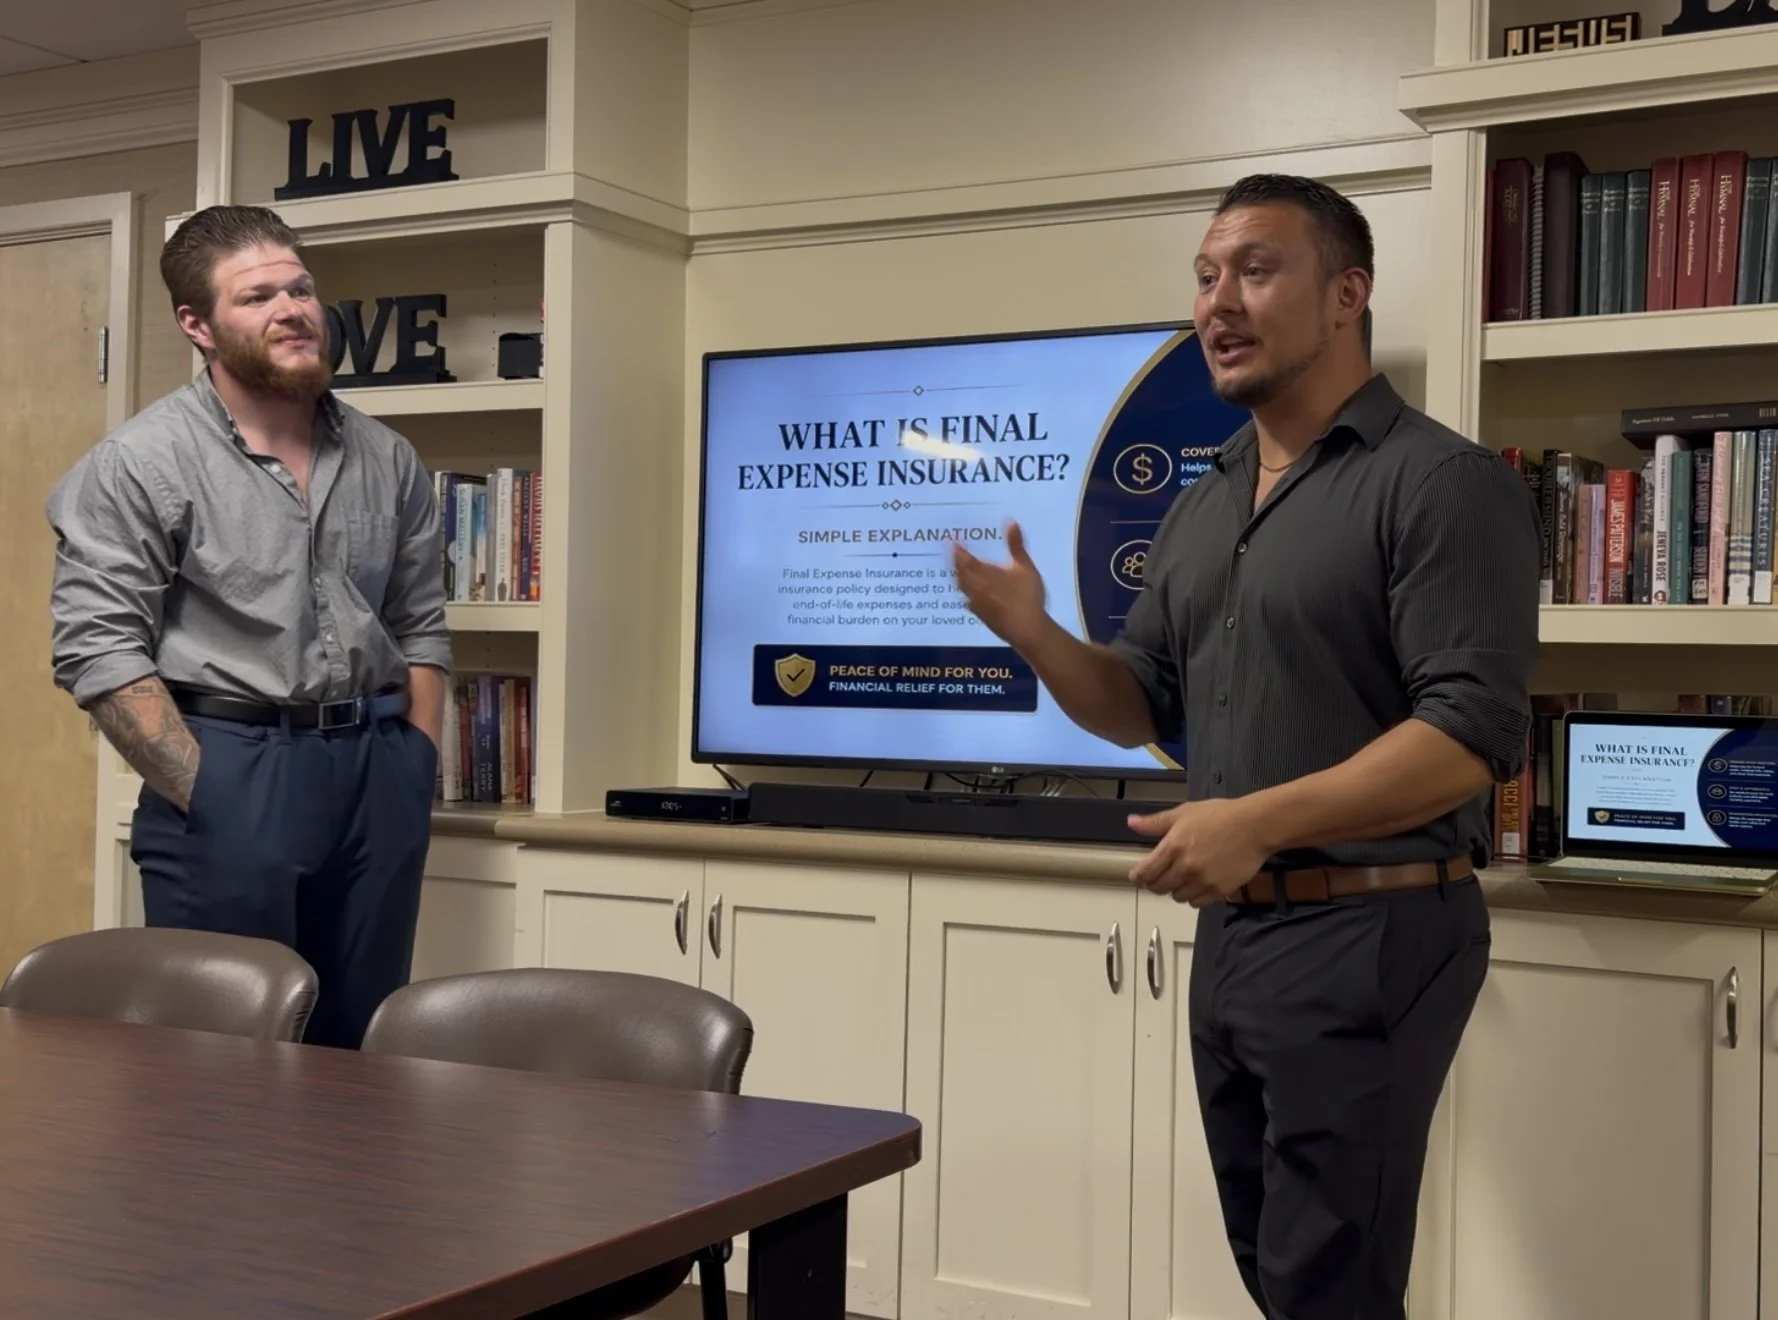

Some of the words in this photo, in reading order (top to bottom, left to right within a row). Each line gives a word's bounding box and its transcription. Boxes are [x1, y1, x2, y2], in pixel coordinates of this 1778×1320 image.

[276, 98, 459, 198] LIVE
[778, 419, 886, 451] WHAT
[897, 417, 929, 448] IS
[940, 412, 1049, 445] FINAL
[738, 460, 868, 490] EXPENSE
[877, 453, 1070, 486] INSURANCE?
[1181, 462, 1212, 474] Helps
[1761, 457, 1772, 480] SEA
[1609, 499, 1625, 523] JAMES
[798, 529, 862, 544] SIMPLE
[868, 527, 1003, 543] EXPLANATION.
[1758, 488, 1770, 566] CREATURES
[1609, 523, 1625, 563] PATTERSON
[1656, 530, 1667, 559] JENEVA
[782, 568, 810, 579] Final
[813, 569, 862, 582] Expense
[865, 568, 924, 579] Insurance
[926, 568, 936, 579] is
[1656, 562, 1667, 582] ROSE
[778, 583, 833, 594] insurance
[836, 583, 872, 596] policy
[874, 583, 930, 596] designed
[932, 584, 945, 594] to
[792, 600, 854, 610] end-of-life
[857, 601, 913, 613] expenses
[915, 600, 940, 610] and
[787, 615, 836, 626] financial
[838, 615, 880, 625] burden
[883, 617, 899, 625] on
[901, 617, 929, 628] your
[932, 615, 965, 626] loved
[829, 665, 875, 677] PEACE
[879, 665, 899, 677] OF
[902, 666, 941, 678] MIND
[945, 667, 974, 679] FOR
[979, 667, 1013, 680] YOU.
[829, 681, 893, 693] FINANCIAL
[896, 682, 936, 694] RELIEF
[939, 683, 964, 694] FOR
[967, 684, 1006, 695] THEM.
[1594, 743, 1634, 754] WHAT
[1636, 744, 1648, 755] IS
[1651, 745, 1688, 756] FINAL
[1580, 754, 1627, 765] EXPENSE
[1629, 755, 1695, 768] INSURANCE?
[1503, 780, 1520, 807] ACCI
